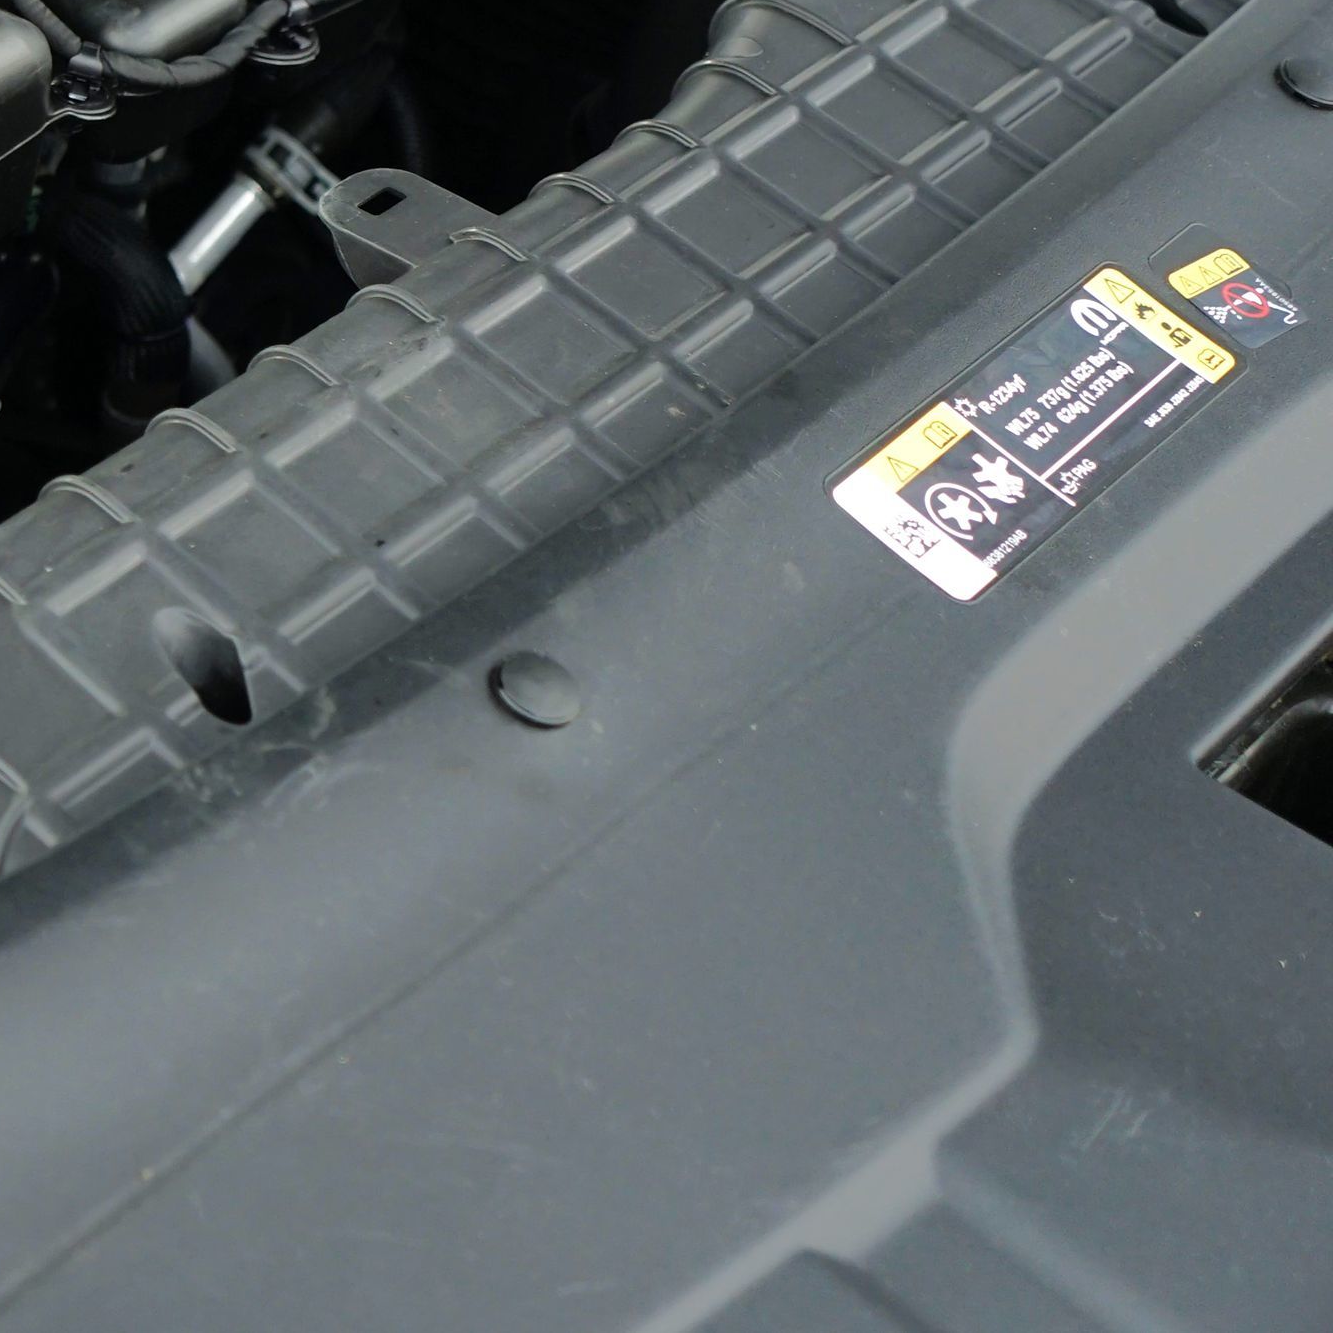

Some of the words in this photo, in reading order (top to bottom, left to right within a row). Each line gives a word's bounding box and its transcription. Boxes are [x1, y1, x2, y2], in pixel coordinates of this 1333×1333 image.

[978, 373, 1027, 414] R-1234yf
[1005, 407, 1041, 436] WL75
[1023, 422, 1059, 450] WL74
[1073, 459, 1097, 479] PAG
